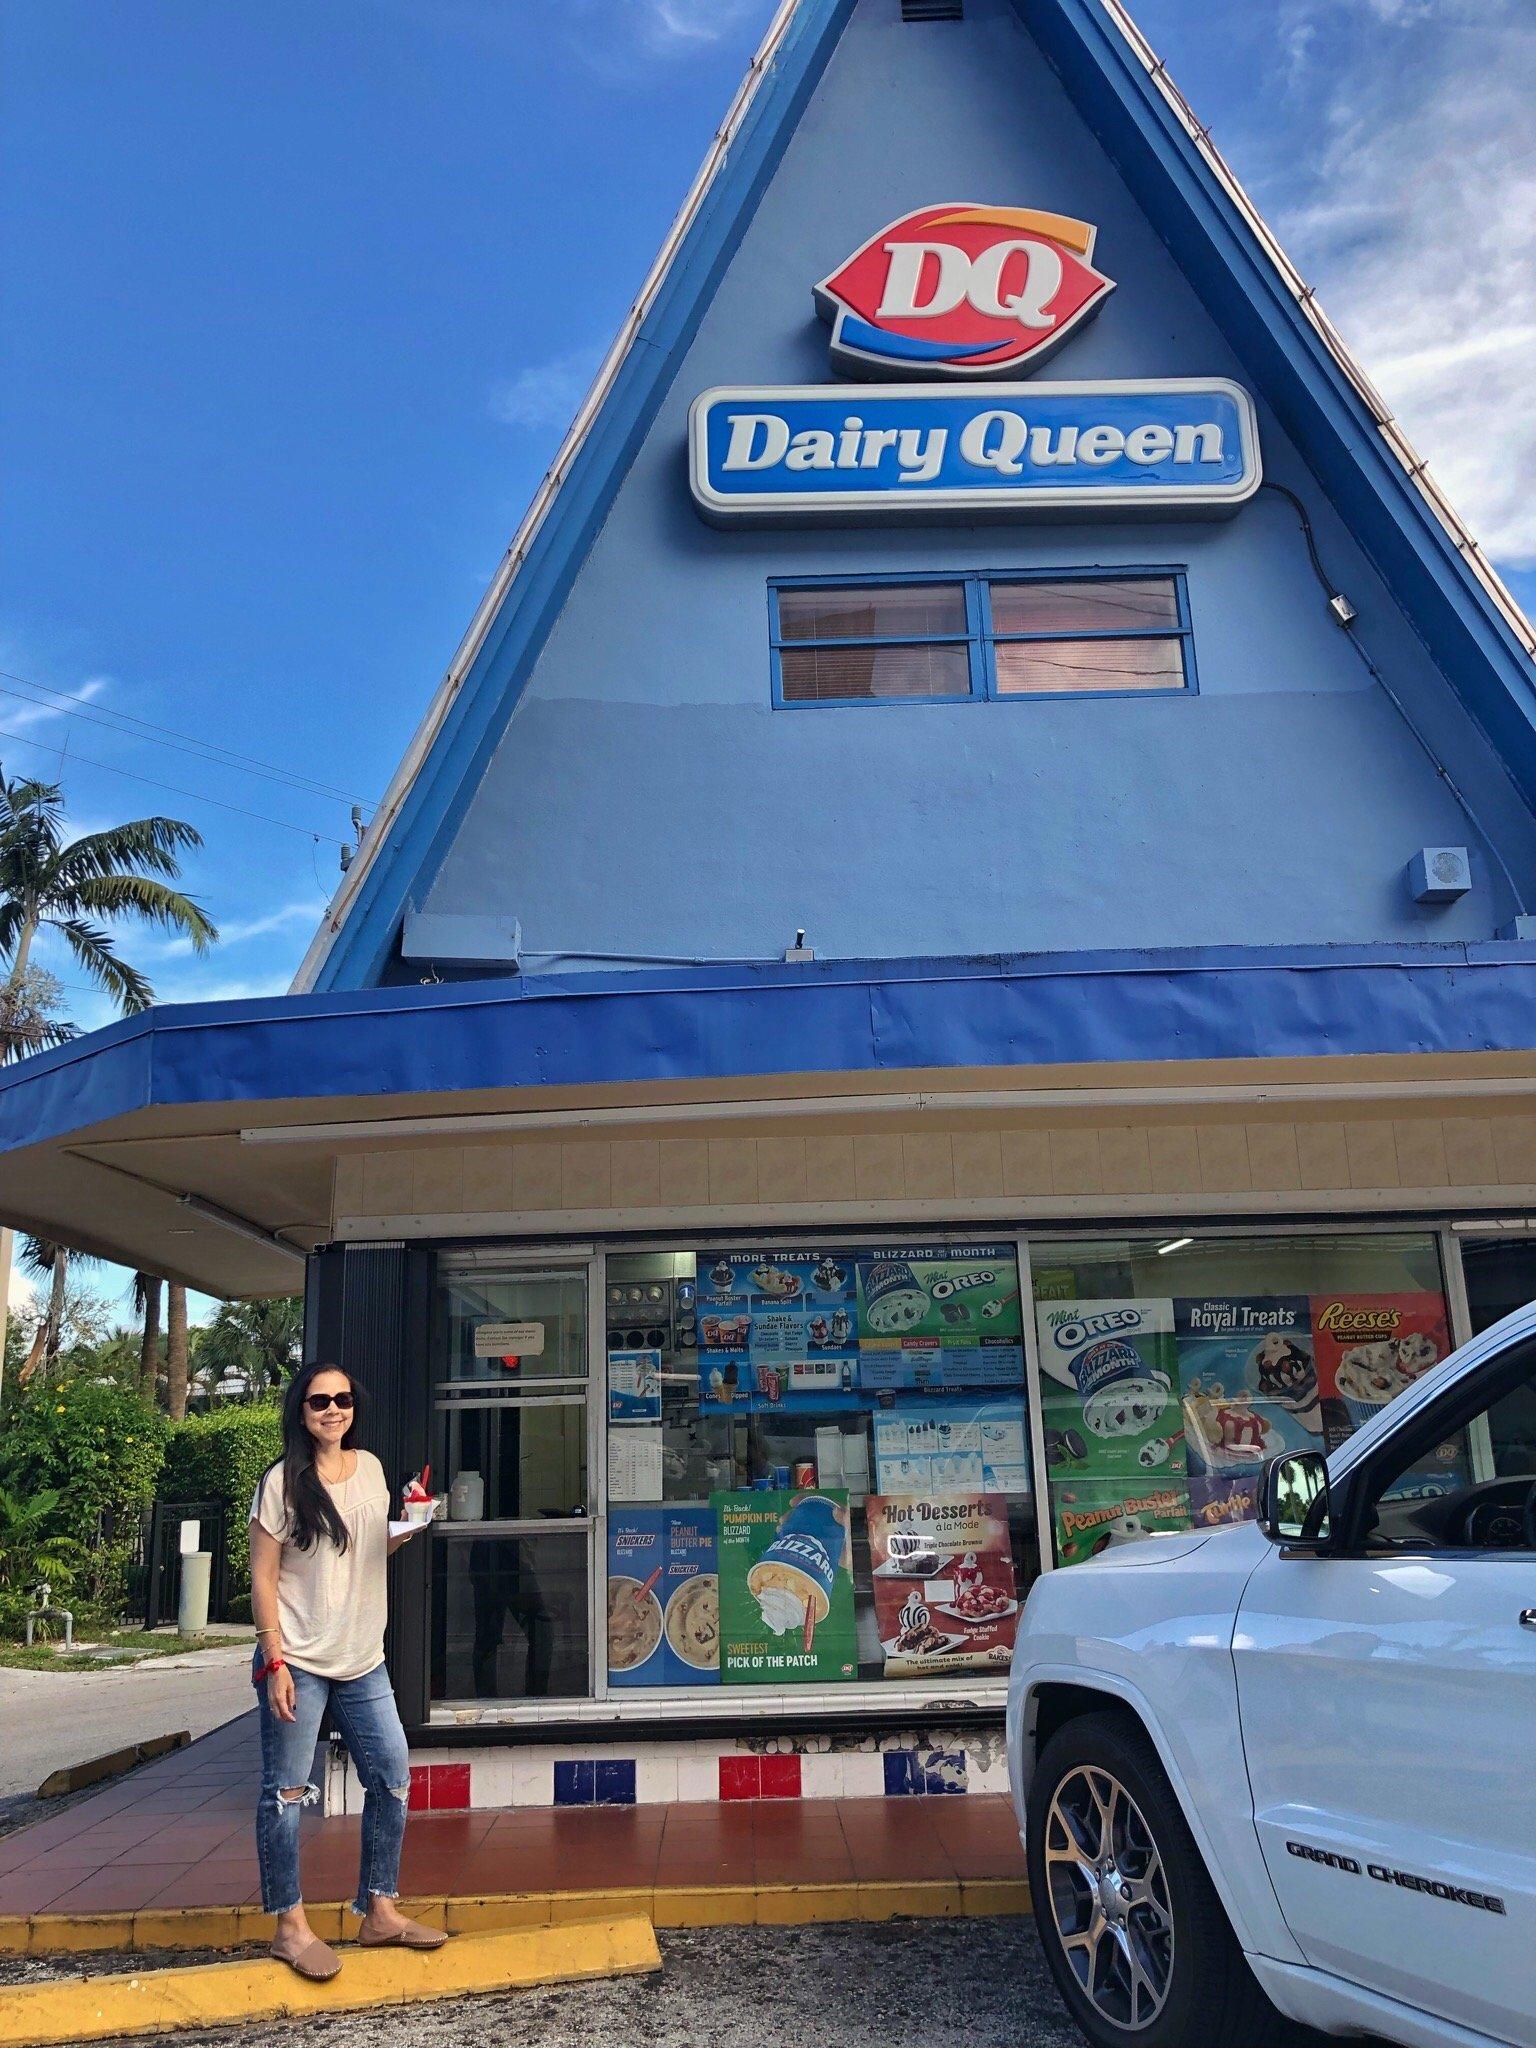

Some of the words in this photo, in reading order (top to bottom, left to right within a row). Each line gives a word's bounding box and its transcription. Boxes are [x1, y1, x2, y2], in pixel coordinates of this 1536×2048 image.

[875, 240, 1063, 328] DQ
[721, 414, 949, 482] Dairy
[960, 410, 1225, 475] Queen
[773, 1252, 820, 1261] TREATS
[873, 1250, 933, 1258] BLIZZARD
[931, 1271, 995, 1299] OREO
[1203, 1302, 1230, 1311] Classic
[767, 1315, 786, 1323] Shake
[1047, 1309, 1079, 1327] Mint
[1190, 1307, 1237, 1332] Royal
[1241, 1307, 1295, 1326] Treats
[1318, 1301, 1402, 1331] Reese's
[1055, 1309, 1141, 1350] OREO
[733, 1504, 752, 1512] Back!
[1124, 1489, 1179, 1516] Buster
[723, 1513, 762, 1523] PUMPKIN
[764, 1512, 778, 1523] PIE
[882, 1504, 915, 1523] Hot
[917, 1500, 993, 1521] Desserts
[1154, 1505, 1188, 1520] Parfait
[944, 1522, 952, 1531] la
[954, 1520, 979, 1530] Mode
[1061, 1505, 1124, 1538] Peanut
[671, 1526, 698, 1536] PEANUT
[723, 1526, 750, 1535] BLIZZARD
[617, 1535, 654, 1546] SNICKERS
[671, 1537, 698, 1548] BUTTER
[699, 1537, 712, 1547] PIE
[766, 1539, 834, 1583] BLIZZARD
[669, 1565, 698, 1573] SNICKERS
[727, 1643, 768, 1655] SWEETEST
[727, 1657, 750, 1668] PICK
[752, 1656, 764, 1667] OF
[766, 1655, 784, 1667] THE
[786, 1654, 818, 1667] PATCH
[920, 1657, 951, 1665] ultimate
[1286, 1841, 1363, 1875] GRAND
[1367, 1864, 1507, 1916] CHEROKEE
